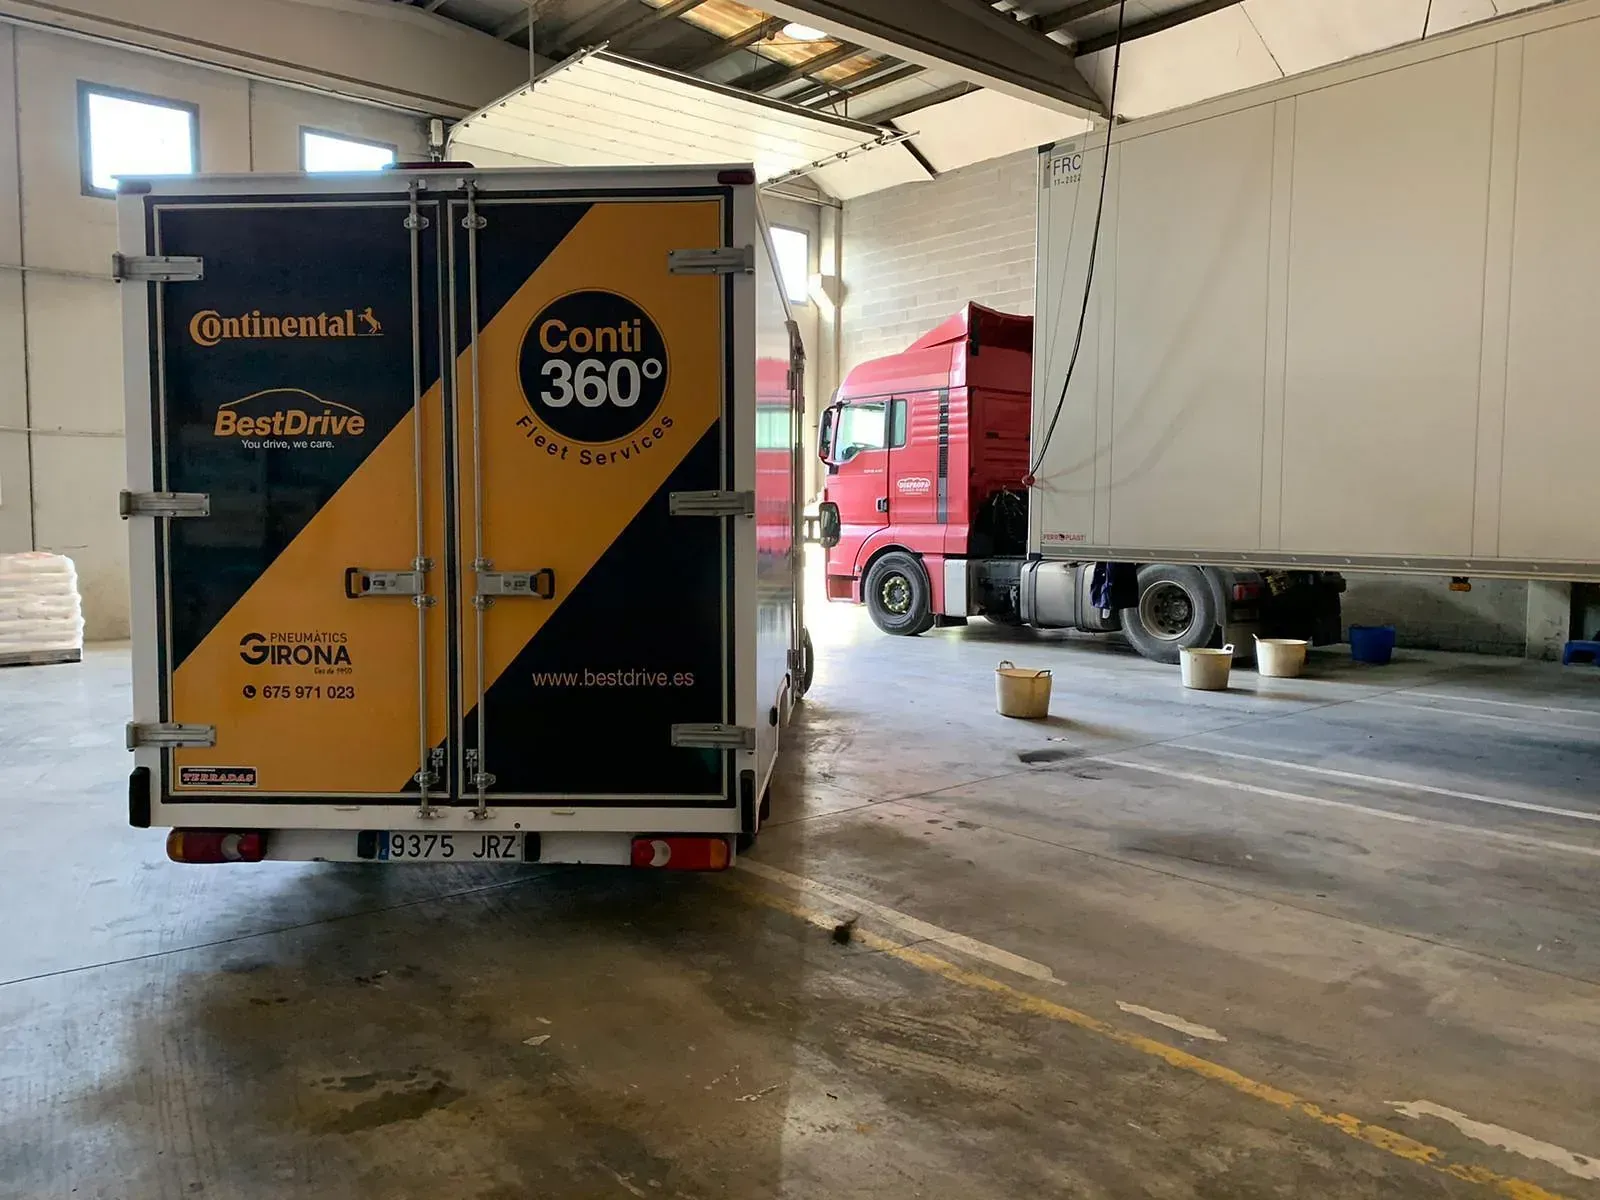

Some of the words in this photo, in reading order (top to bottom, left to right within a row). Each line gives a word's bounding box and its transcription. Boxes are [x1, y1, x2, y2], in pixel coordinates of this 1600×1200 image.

[1053, 154, 1081, 176] FRC
[189, 309, 356, 346] Continental
[539, 318, 642, 353] Conti
[540, 358, 663, 408] 360°
[214, 410, 365, 436] BestDrive
[241, 439, 261, 449] You
[262, 439, 291, 450] drive,
[292, 441, 309, 449] we
[310, 441, 335, 449] care.
[515, 415, 569, 460] Fleet
[579, 415, 674, 465] Services
[270, 629, 348, 643] PNEUMÀTICS
[240, 632, 352, 665] GIRONA
[532, 668, 695, 687] www.bestdrive.es
[263, 685, 291, 699] 675
[295, 685, 321, 699] 971
[327, 686, 355, 699] 023
[182, 773, 254, 782] TERRADAS
[391, 834, 454, 858] 9375
[472, 835, 516, 858] JRZ
